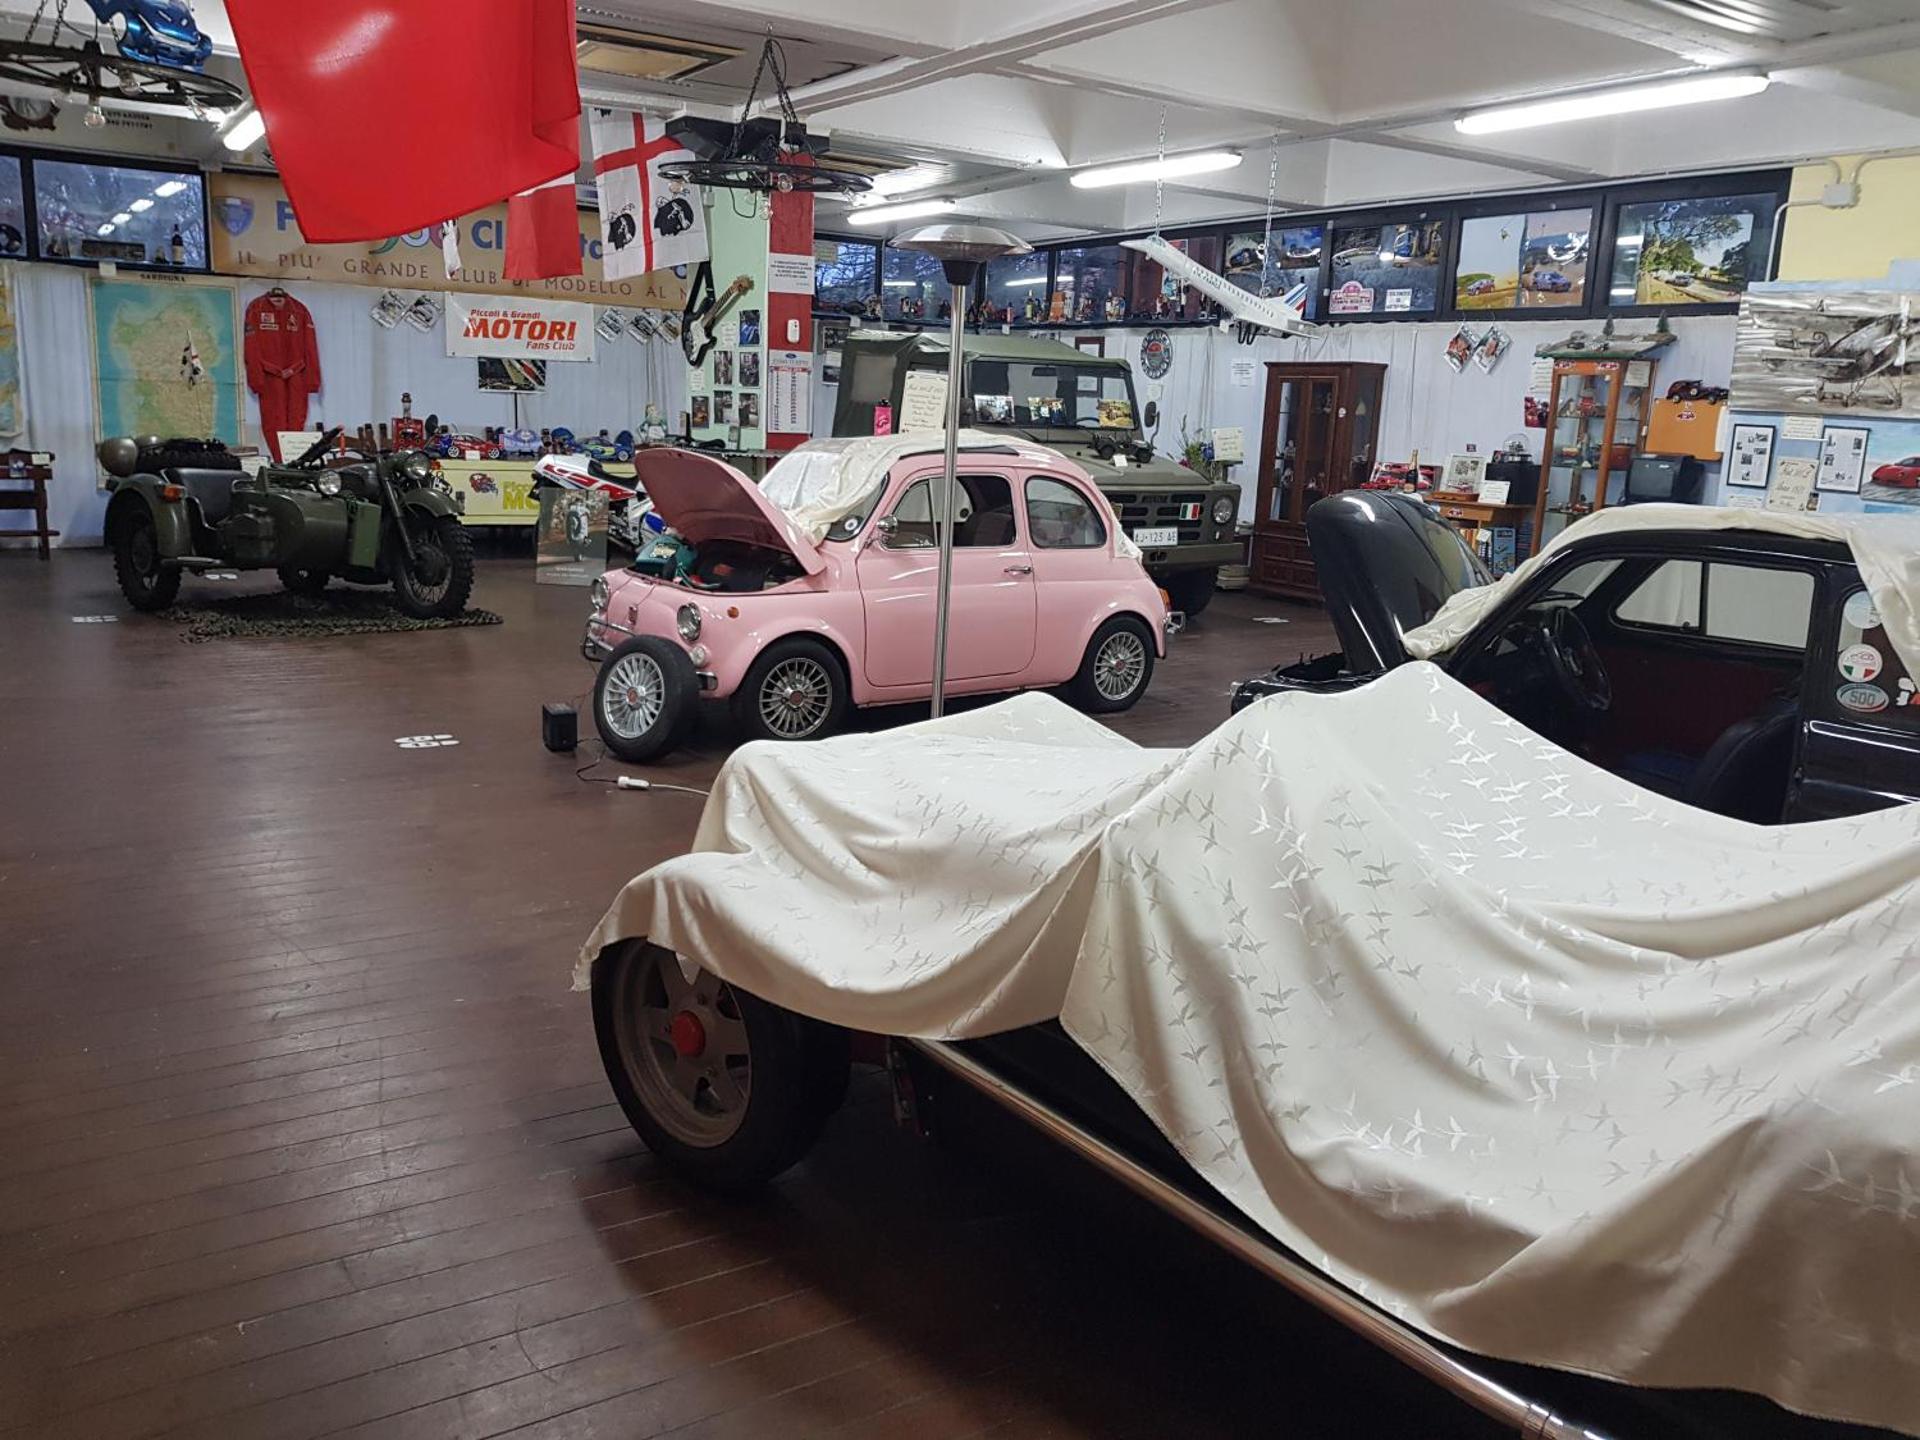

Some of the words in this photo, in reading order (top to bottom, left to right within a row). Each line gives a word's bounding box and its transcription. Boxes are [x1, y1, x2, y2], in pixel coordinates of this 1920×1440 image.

[237, 251, 257, 265] IL
[343, 259, 429, 279] GRANDE
[544, 278, 632, 297] MODELLO
[645, 285, 666, 300] AL
[470, 309, 500, 318] Piccoli
[502, 310, 509, 318] &
[510, 311, 541, 319] Grandi
[463, 318, 577, 341] MOTORI
[525, 341, 550, 350] Fans
[552, 342, 576, 350] Club
[1849, 690, 1876, 706] 500
